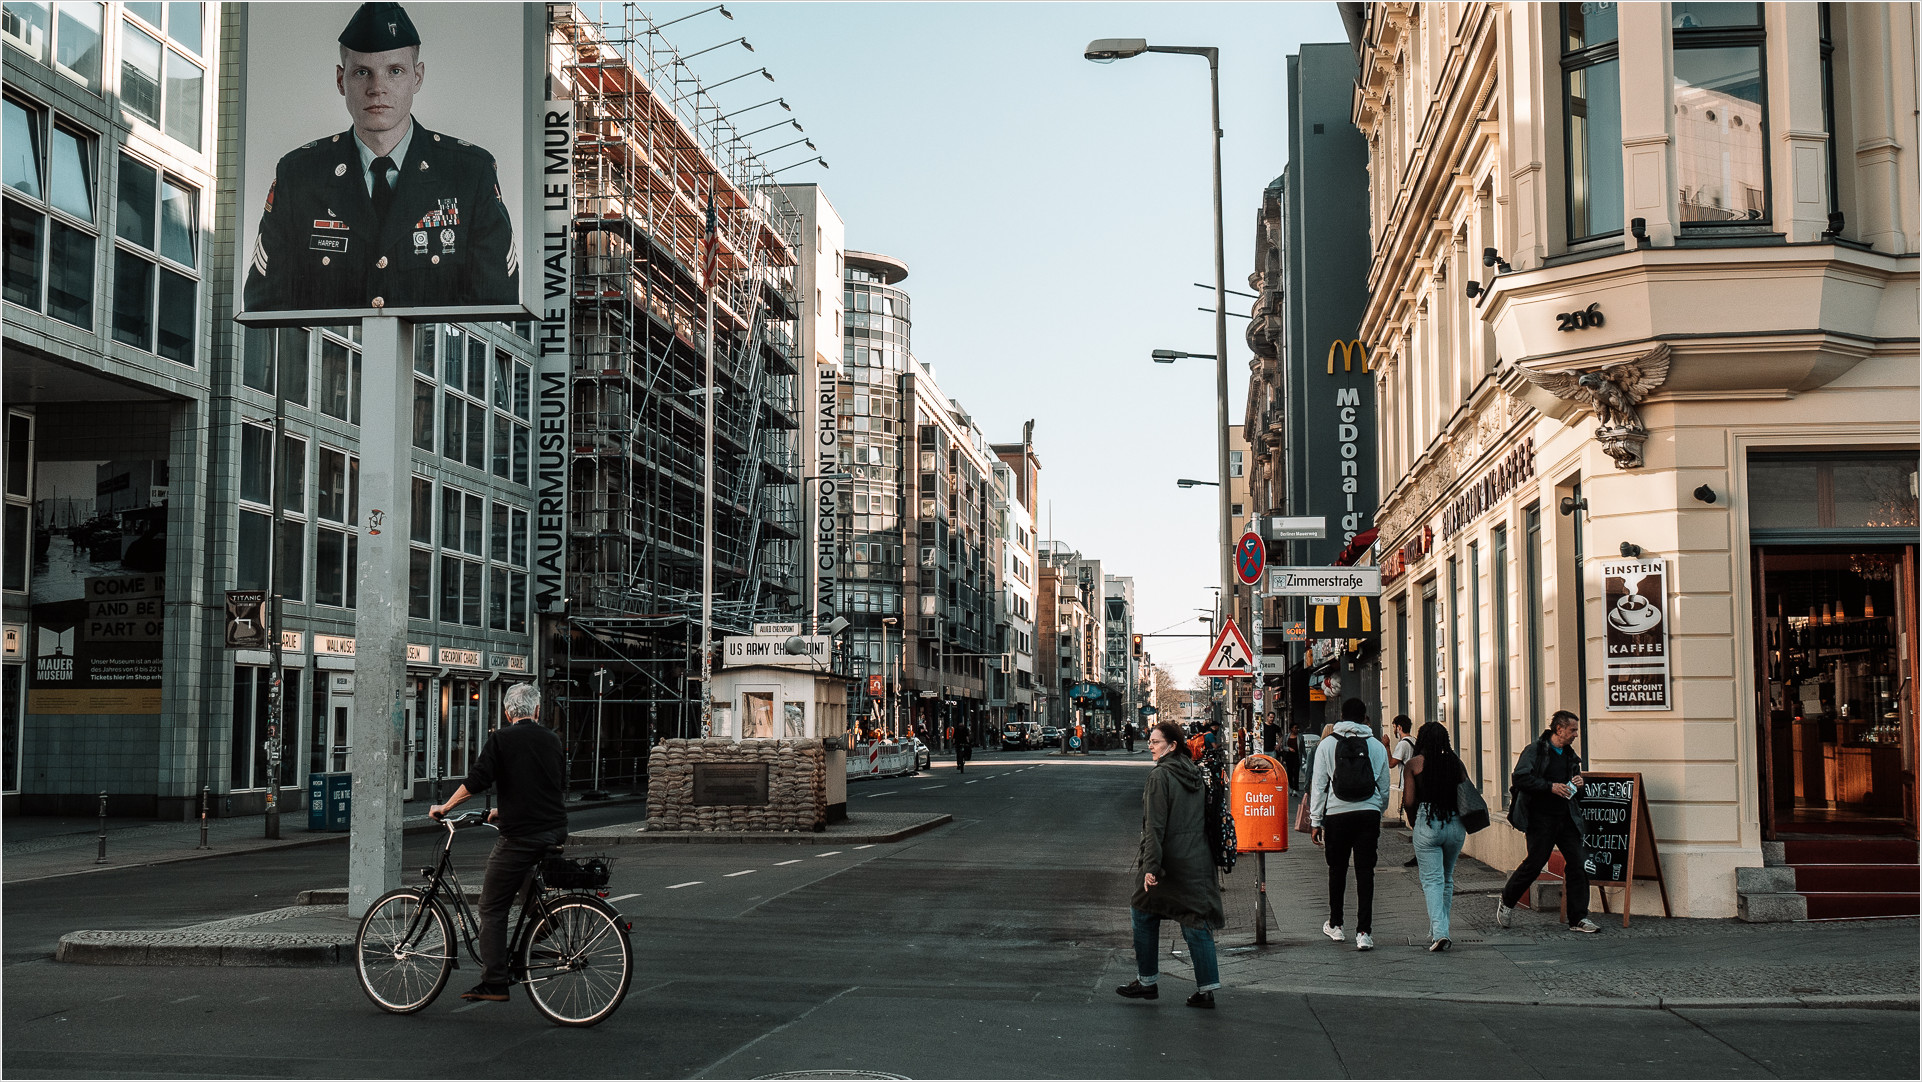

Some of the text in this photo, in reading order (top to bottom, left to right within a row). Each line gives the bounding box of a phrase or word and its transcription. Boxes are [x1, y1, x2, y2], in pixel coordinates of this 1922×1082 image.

[317, 239, 340, 248] HARPER
[1555, 301, 1605, 332] 206
[537, 110, 570, 600] MAUERMUSEUM THE WALL LE MUR
[1336, 387, 1364, 547] McDonald's
[818, 369, 836, 608] AM CHECKPOINT CHARLIE
[1604, 563, 1662, 575] EINSTEIN
[93, 578, 145, 595] COME
[1286, 574, 1363, 589] Zimmerstraße
[96, 602, 155, 616] AND BE
[91, 622, 136, 636] PART
[759, 625, 795, 633] ALLIED CHECKPOINT
[326, 639, 355, 654] WALL MUSEU
[729, 642, 825, 656] US ARMY CHOINT
[1609, 643, 1662, 654] KAFFEE
[37, 658, 74, 671] MAUER
[441, 650, 478, 665] CHECKPOINT CHARLIE
[510, 657, 523, 669] CHARLIE
[36, 670, 73, 681] MUSEUM
[134, 674, 151, 682] Shop
[1610, 683, 1663, 692] CHECKPOINT
[1611, 691, 1663, 702] CHARLIE
[1245, 791, 1274, 803] Guter
[1584, 781, 1634, 799] ANGEBOT
[1244, 805, 1275, 817] Einfall
[1582, 834, 1628, 850] KUCHEN
